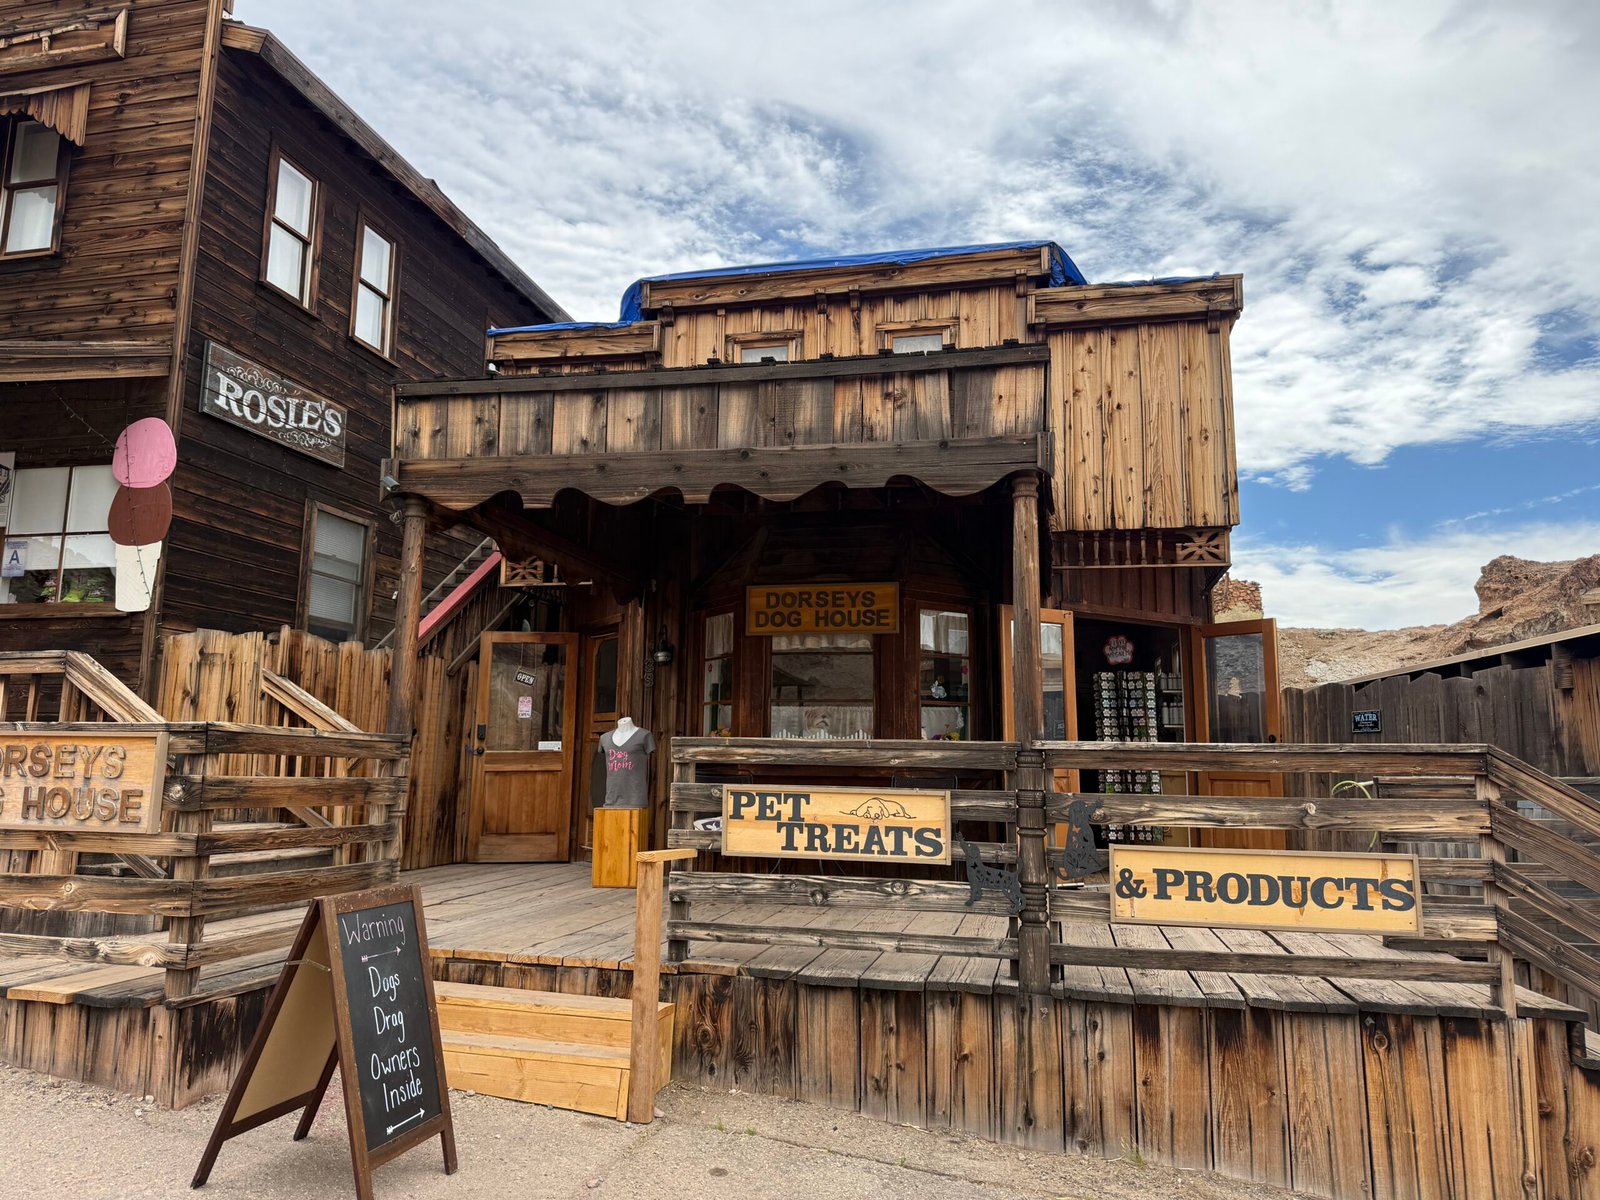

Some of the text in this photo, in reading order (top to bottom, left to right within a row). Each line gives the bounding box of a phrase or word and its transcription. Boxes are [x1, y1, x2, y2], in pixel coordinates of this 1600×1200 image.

[214, 371, 342, 437] ROSIE'S
[9, 549, 20, 564] A
[765, 590, 876, 609] DORSEYS
[755, 608, 890, 628] DOG HOUSE
[516, 673, 535, 684] OPEN
[1354, 713, 1377, 722] WATER
[0, 744, 126, 779] RSEYS
[21, 786, 143, 823] HOUSE
[729, 791, 810, 822] PET
[776, 821, 944, 857] TREATS
[1115, 867, 1415, 911] & PRODUCTS
[342, 914, 406, 945] Warning
[368, 966, 401, 1001] Dogs
[373, 1006, 404, 1044] Drag
[371, 1046, 420, 1080] Owners
[382, 1069, 423, 1113] Inside
